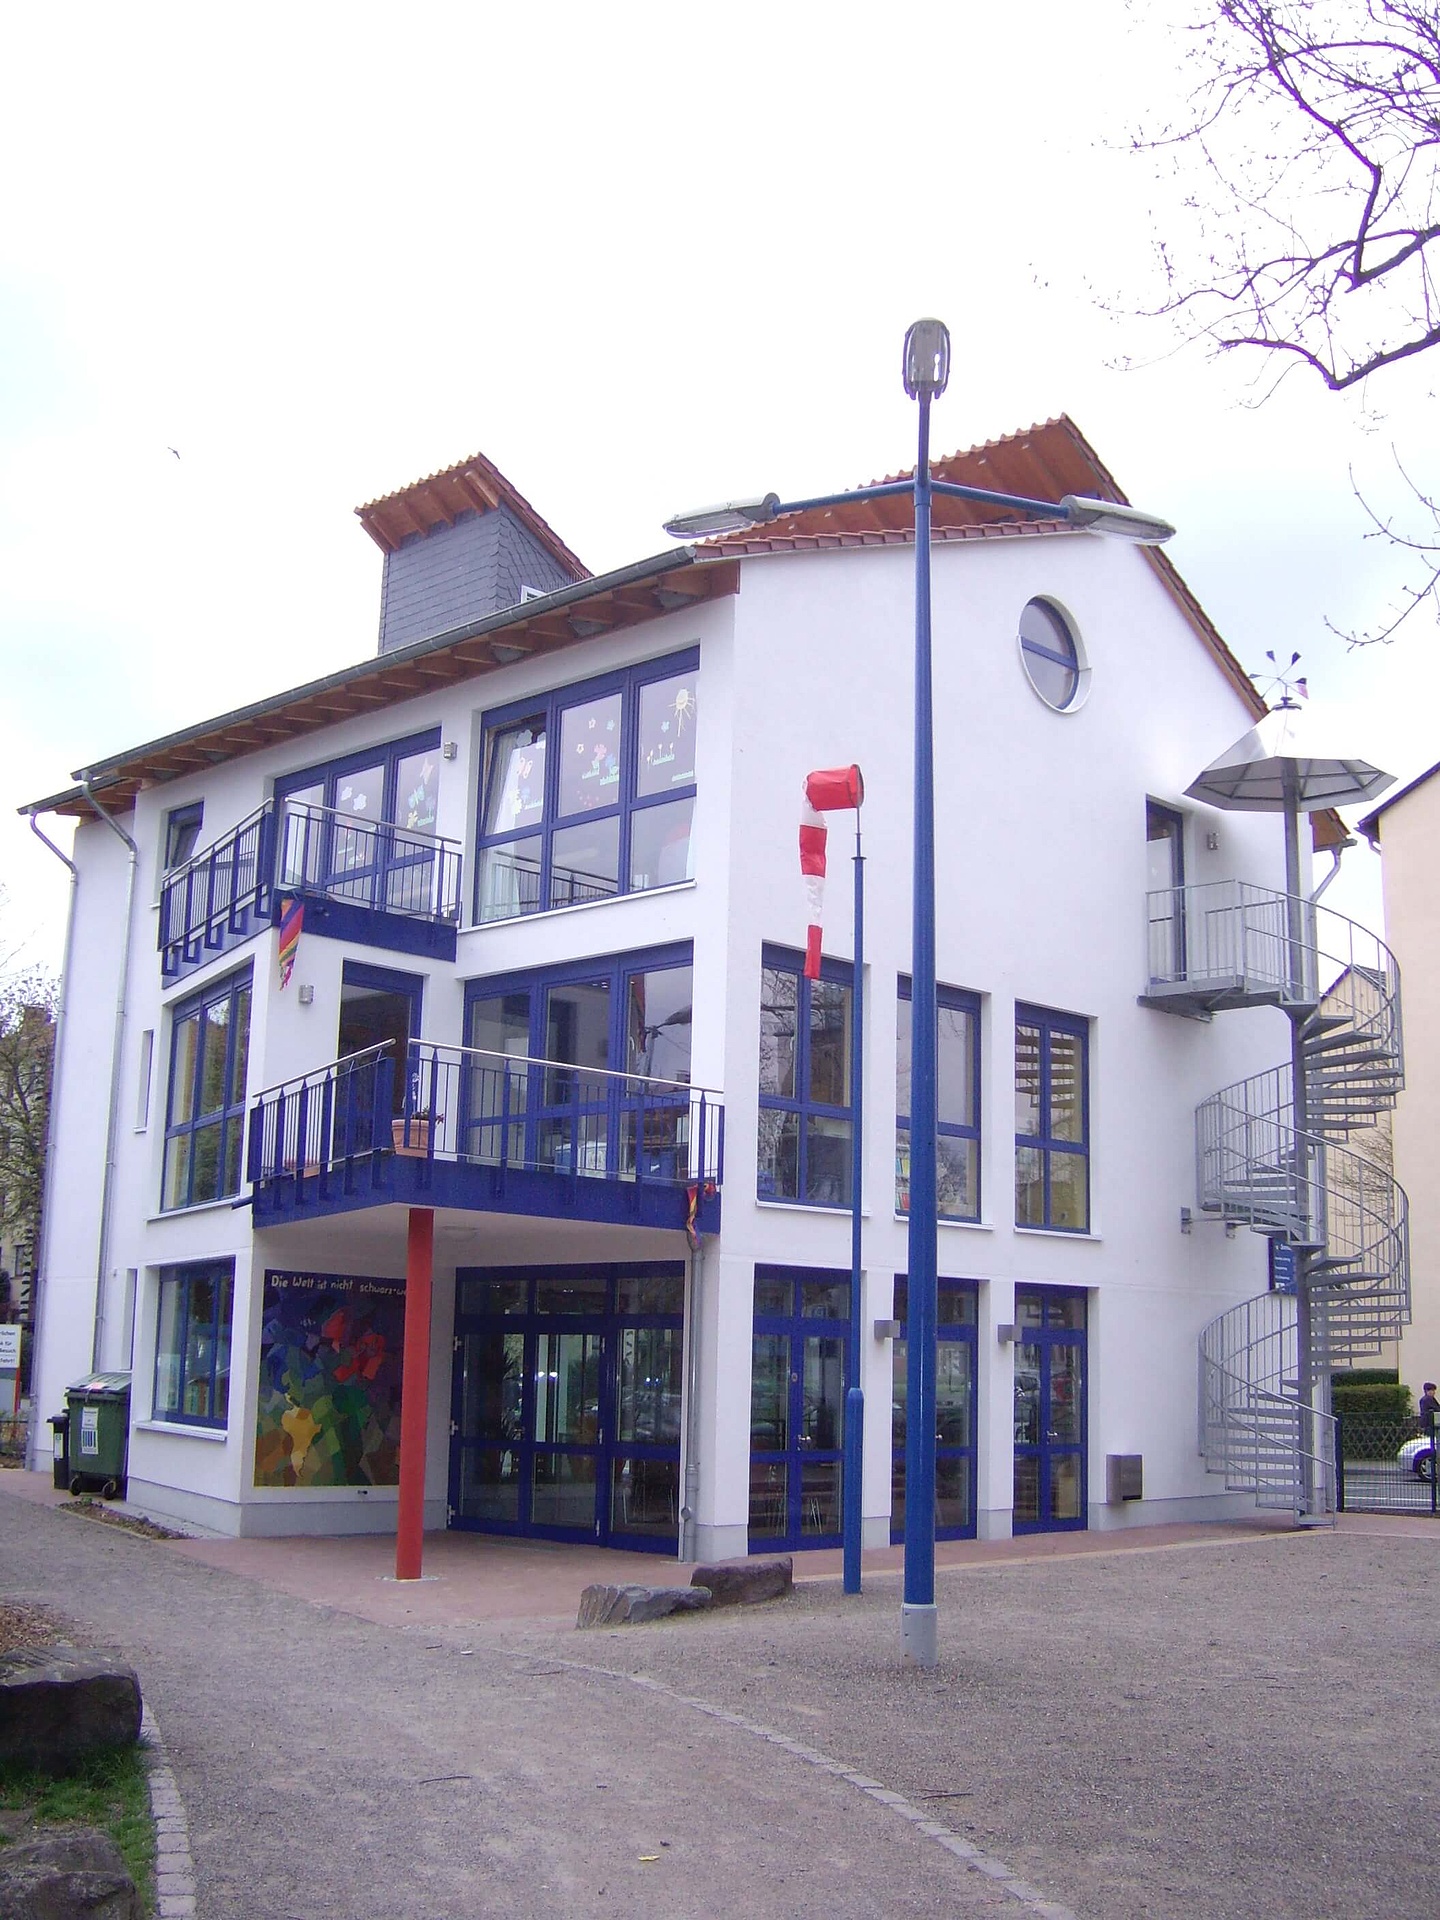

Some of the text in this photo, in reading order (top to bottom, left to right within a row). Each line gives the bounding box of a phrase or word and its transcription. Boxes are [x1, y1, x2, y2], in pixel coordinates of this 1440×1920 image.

[271, 1275, 288, 1288] Die
[292, 1276, 314, 1288] Welt
[317, 1280, 327, 1290] ist
[330, 1279, 353, 1291] nicht
